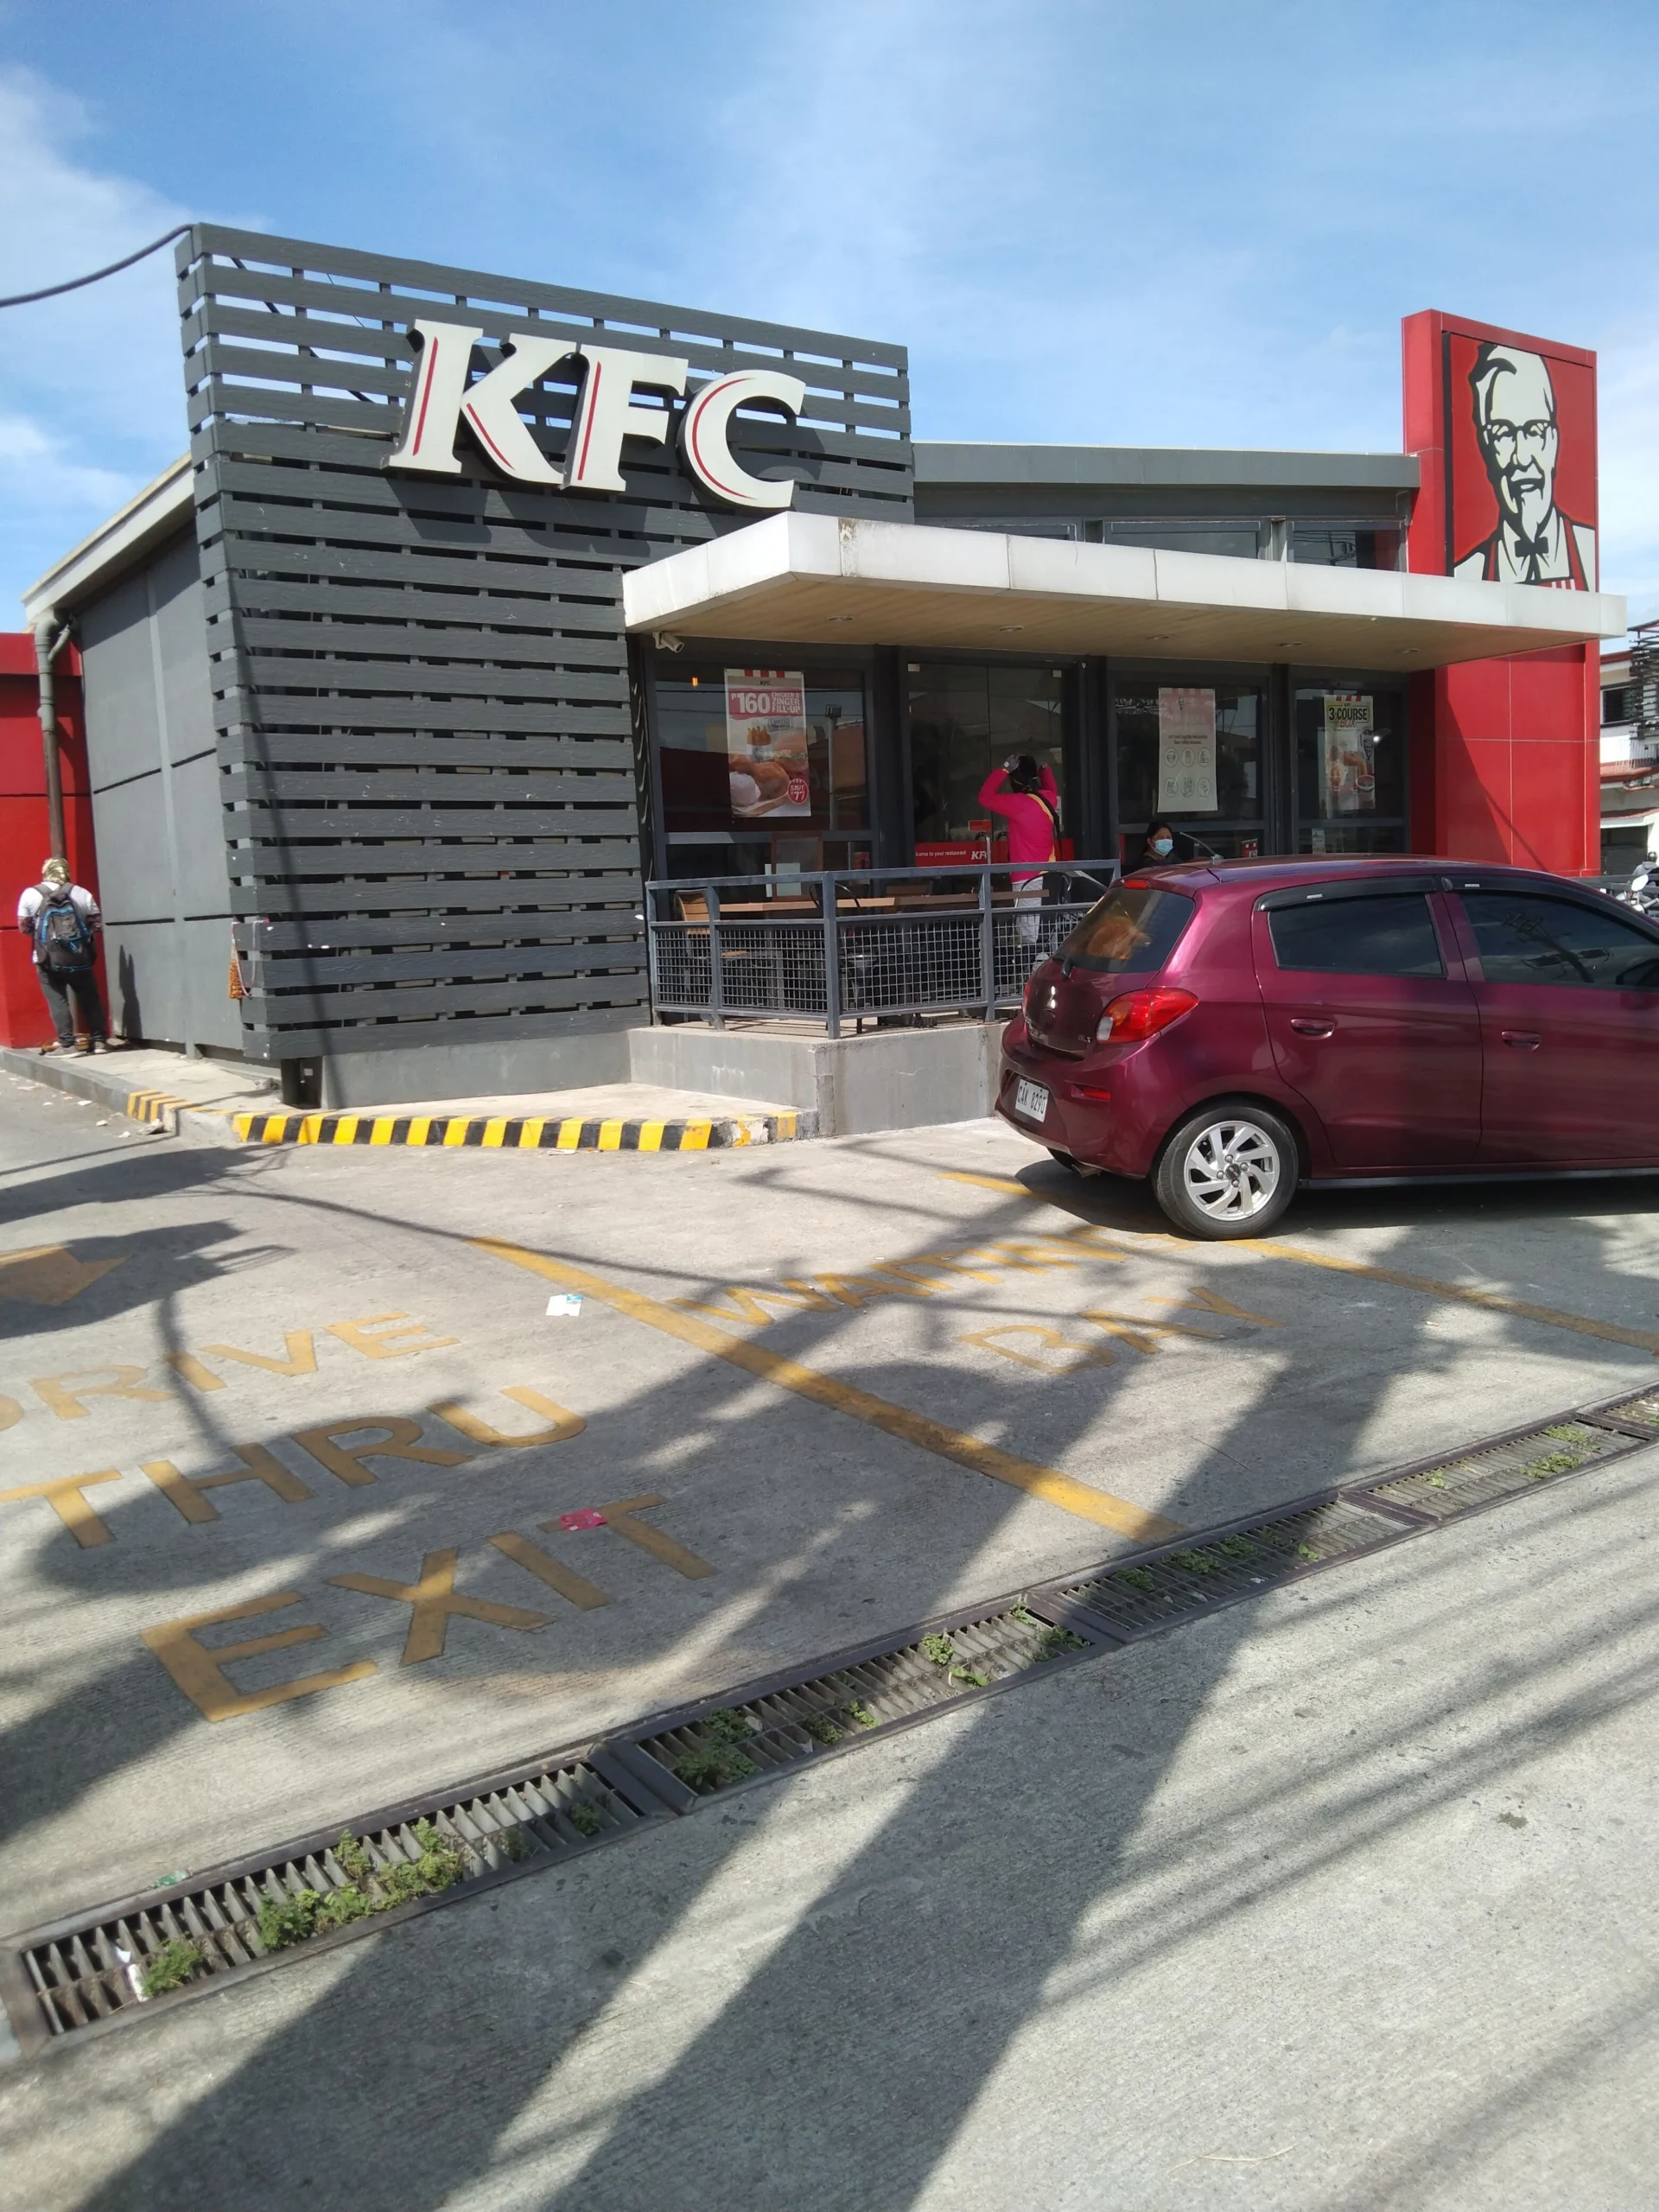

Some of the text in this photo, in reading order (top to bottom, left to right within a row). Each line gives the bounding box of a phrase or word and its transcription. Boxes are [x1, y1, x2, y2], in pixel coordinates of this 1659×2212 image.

[381, 319, 806, 508] KFC
[772, 697, 800, 706] ZINGER
[772, 705, 801, 714] FILL-UP
[1340, 719, 1356, 728] BOX
[0, 1311, 461, 1432] RIVE
[956, 1286, 1287, 1375] BAY
[0, 1385, 588, 1549] THRU
[141, 1493, 724, 1723] EXIT
